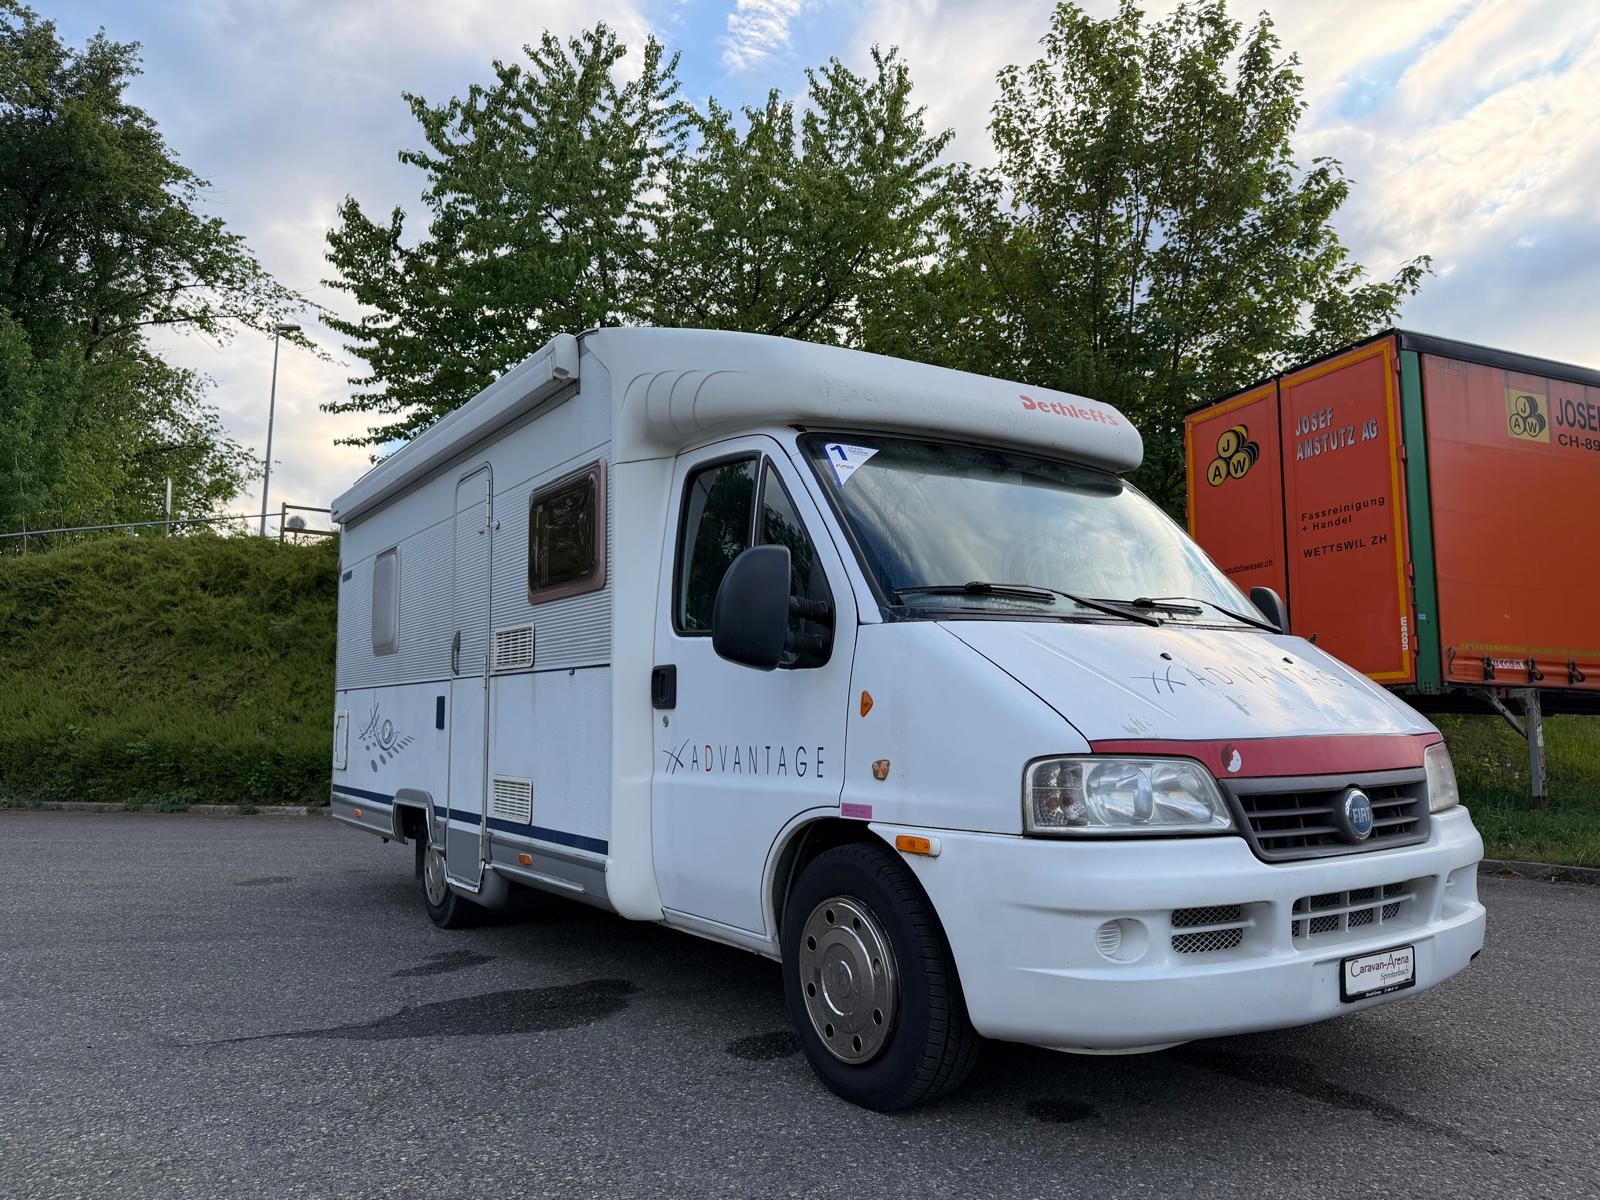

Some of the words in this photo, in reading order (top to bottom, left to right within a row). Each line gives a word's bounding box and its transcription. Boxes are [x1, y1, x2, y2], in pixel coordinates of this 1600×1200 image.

[1295, 406, 1333, 437] JOSEF
[1513, 417, 1522, 430] A
[1527, 420, 1538, 434] W
[1222, 439, 1230, 452] J
[1296, 425, 1355, 461] AMSTUTZ
[1361, 417, 1378, 441] AG
[830, 445, 848, 461] 1
[1212, 465, 1223, 482] A
[1231, 456, 1247, 475] W
[1301, 496, 1385, 522] Fassreinigung
[1312, 514, 1352, 531] Handel
[1303, 538, 1366, 558] WETTSWIL
[1370, 534, 1387, 546] ZH
[691, 744, 825, 778] ADVANTAGE
[1352, 806, 1370, 824] FIAT
[1350, 953, 1409, 978] Caravan-Arena
